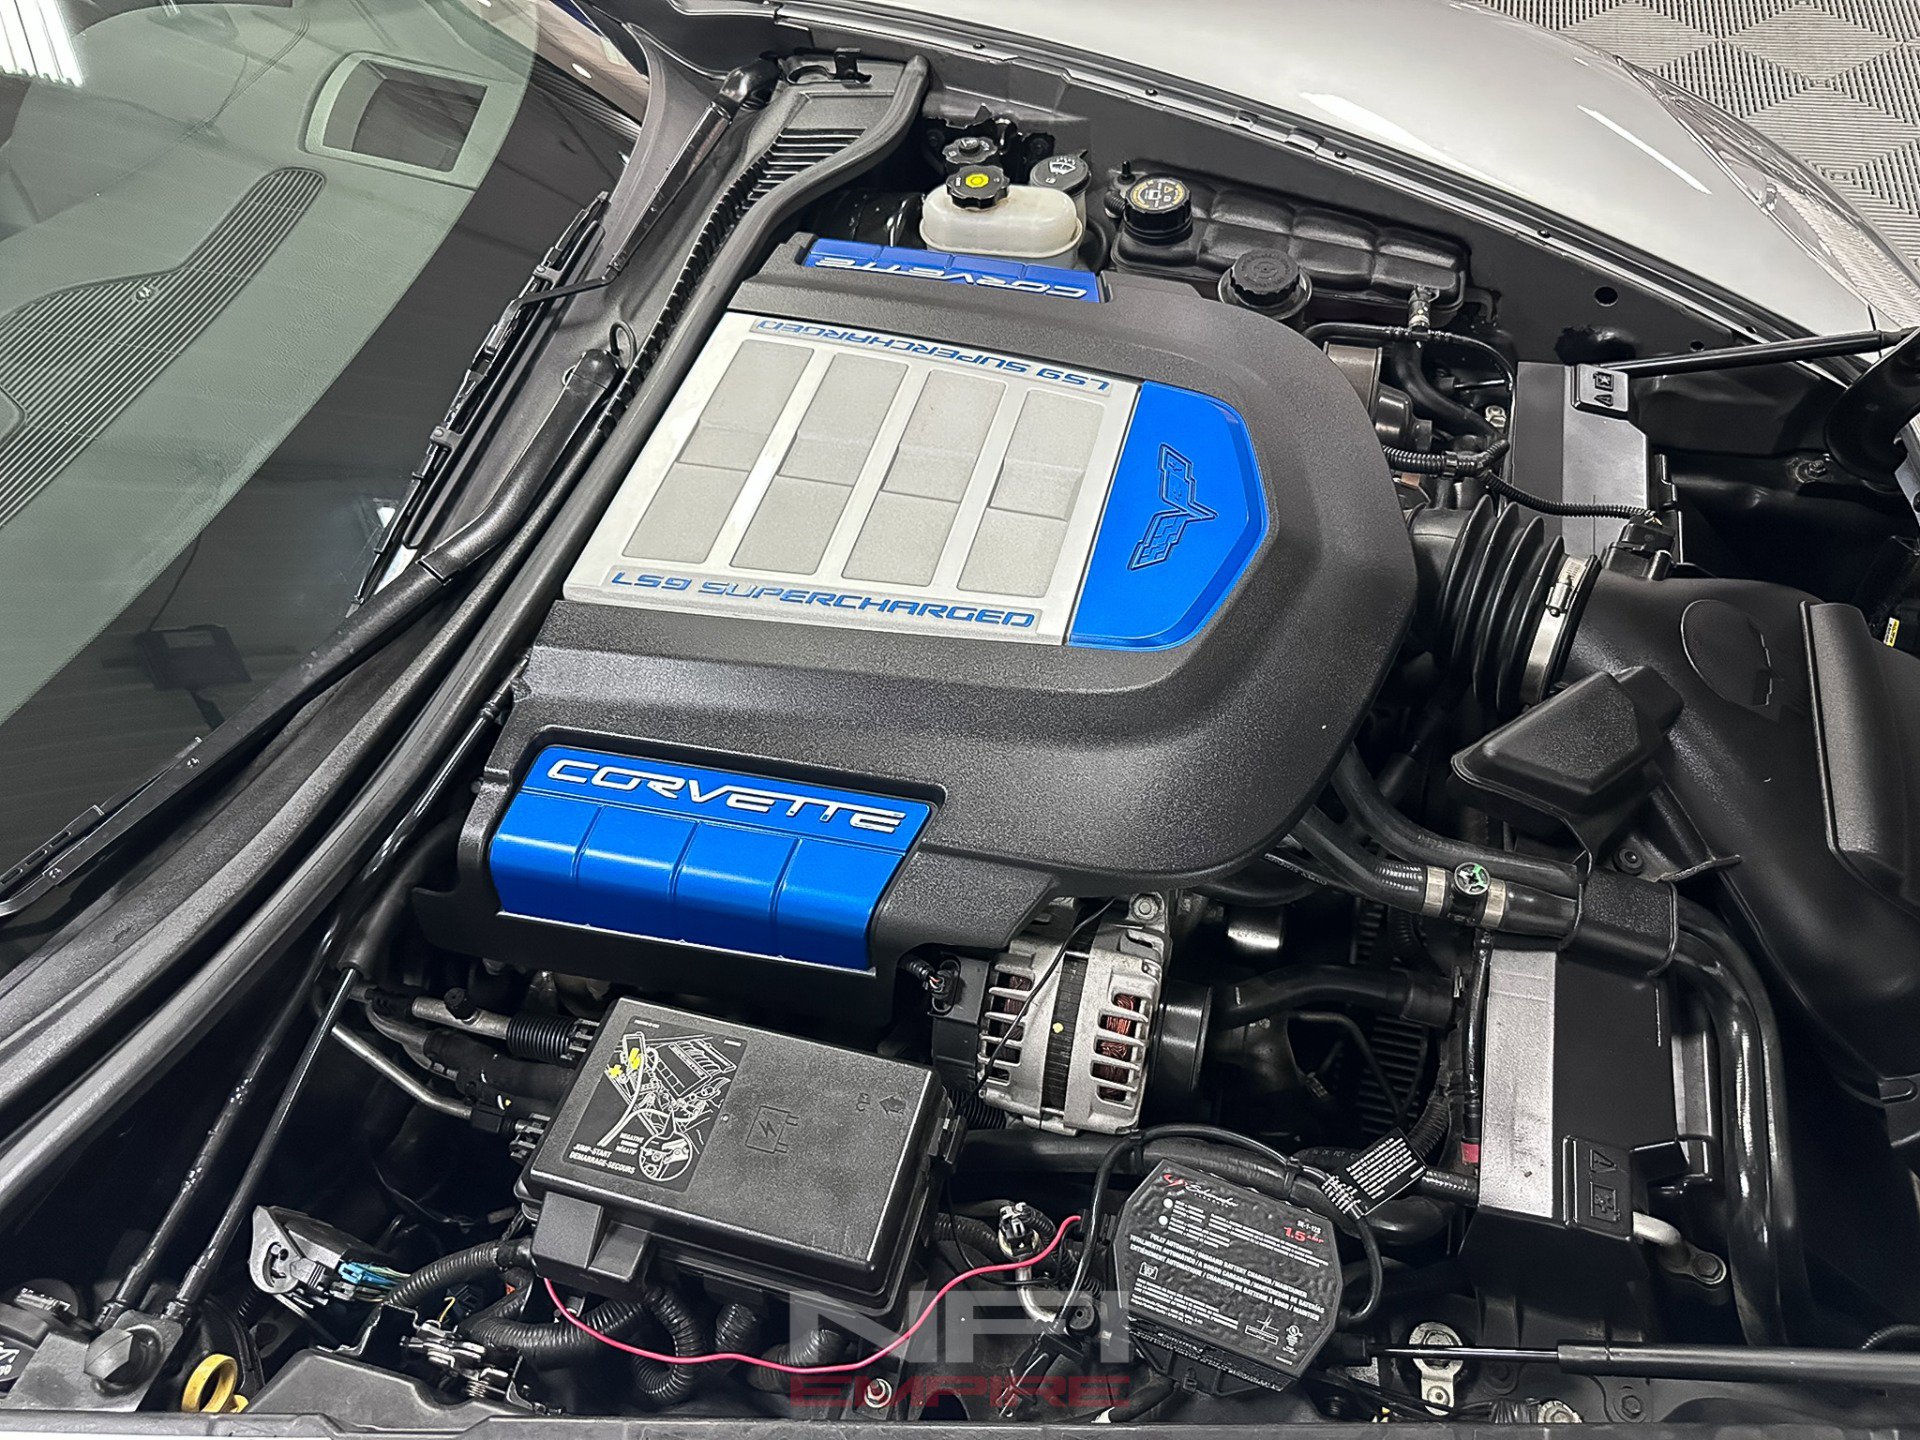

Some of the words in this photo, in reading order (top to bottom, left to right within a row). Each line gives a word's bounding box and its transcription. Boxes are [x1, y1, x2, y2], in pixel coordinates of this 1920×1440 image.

[815, 256, 1088, 299] CORVETTE
[757, 319, 1029, 375] SUPERCHARGED
[1035, 367, 1111, 392] LS9
[611, 571, 693, 591] LS9
[698, 580, 1036, 628] SUPERCHARGED
[546, 757, 907, 835] CORVETTE
[1284, 1226, 1306, 1242] 1.5
